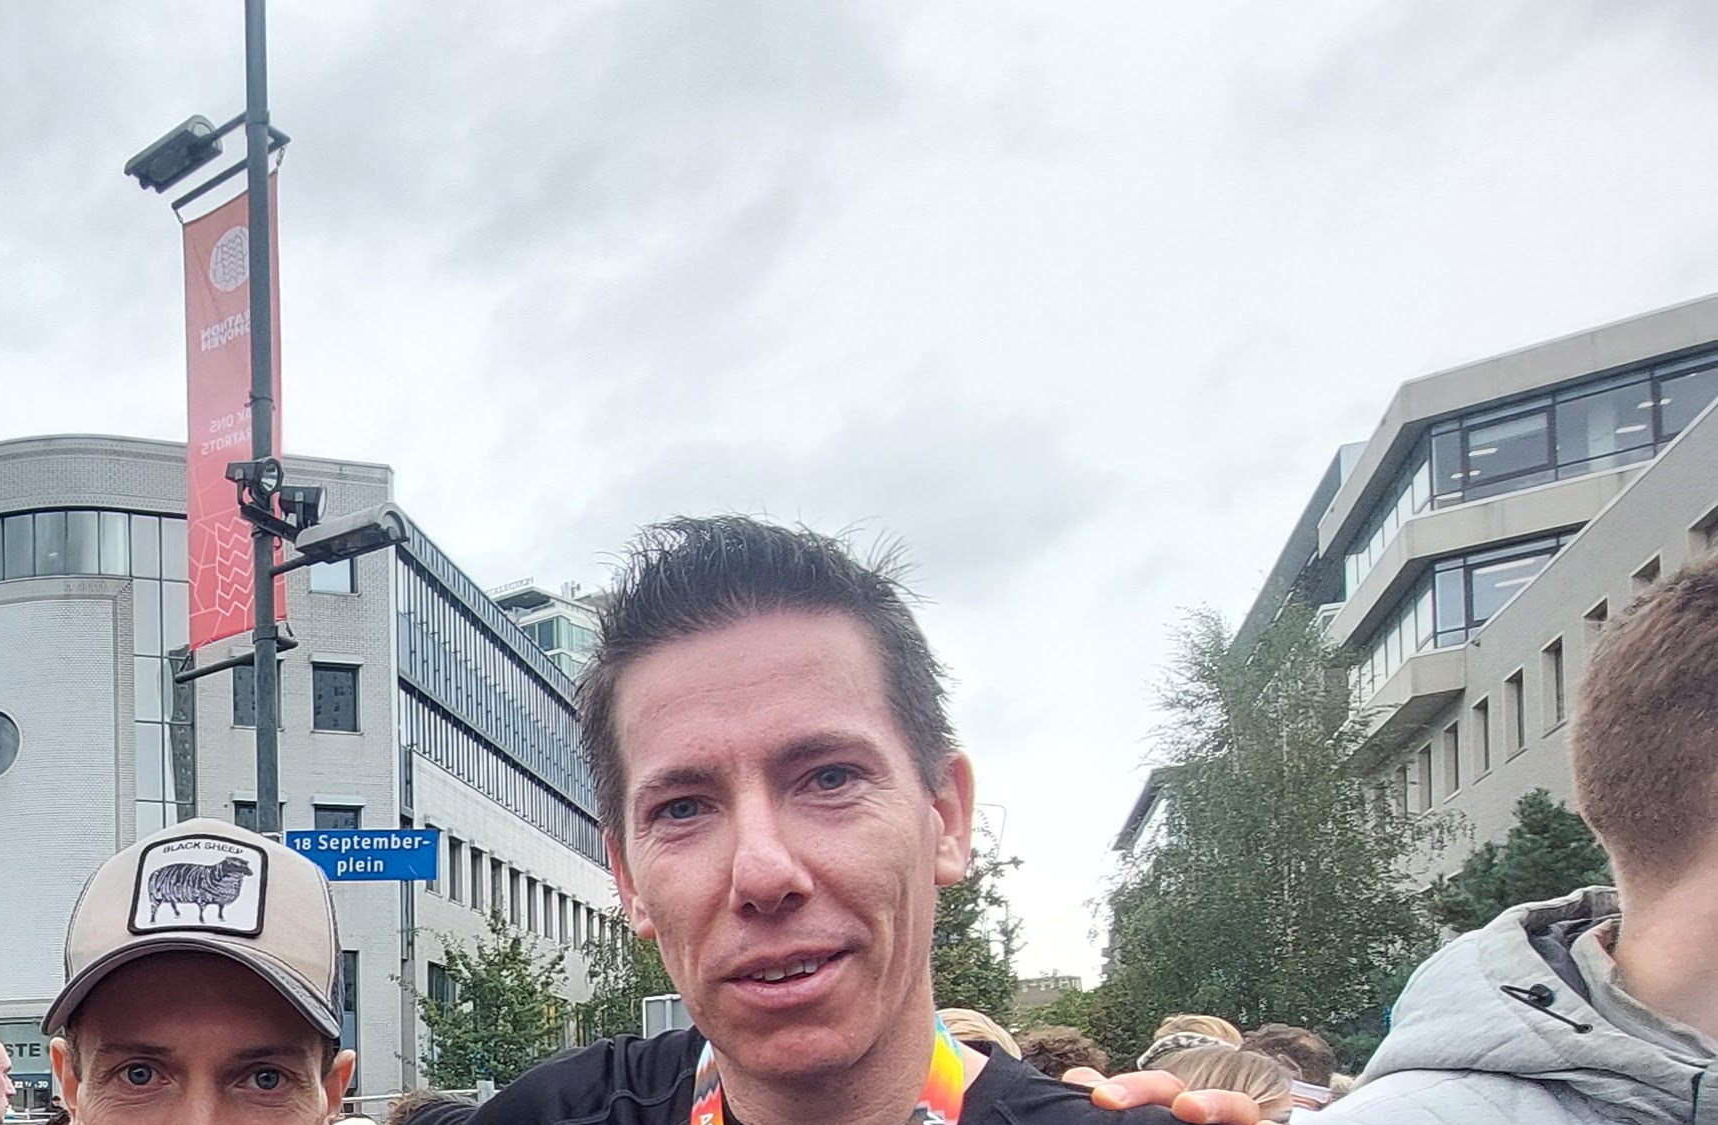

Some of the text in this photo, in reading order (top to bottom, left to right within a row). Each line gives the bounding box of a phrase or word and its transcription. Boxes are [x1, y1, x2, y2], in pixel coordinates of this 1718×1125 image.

[162, 841, 244, 855] BLACK SHEEP
[293, 834, 431, 854] 18 September-
[337, 856, 384, 877] plein
